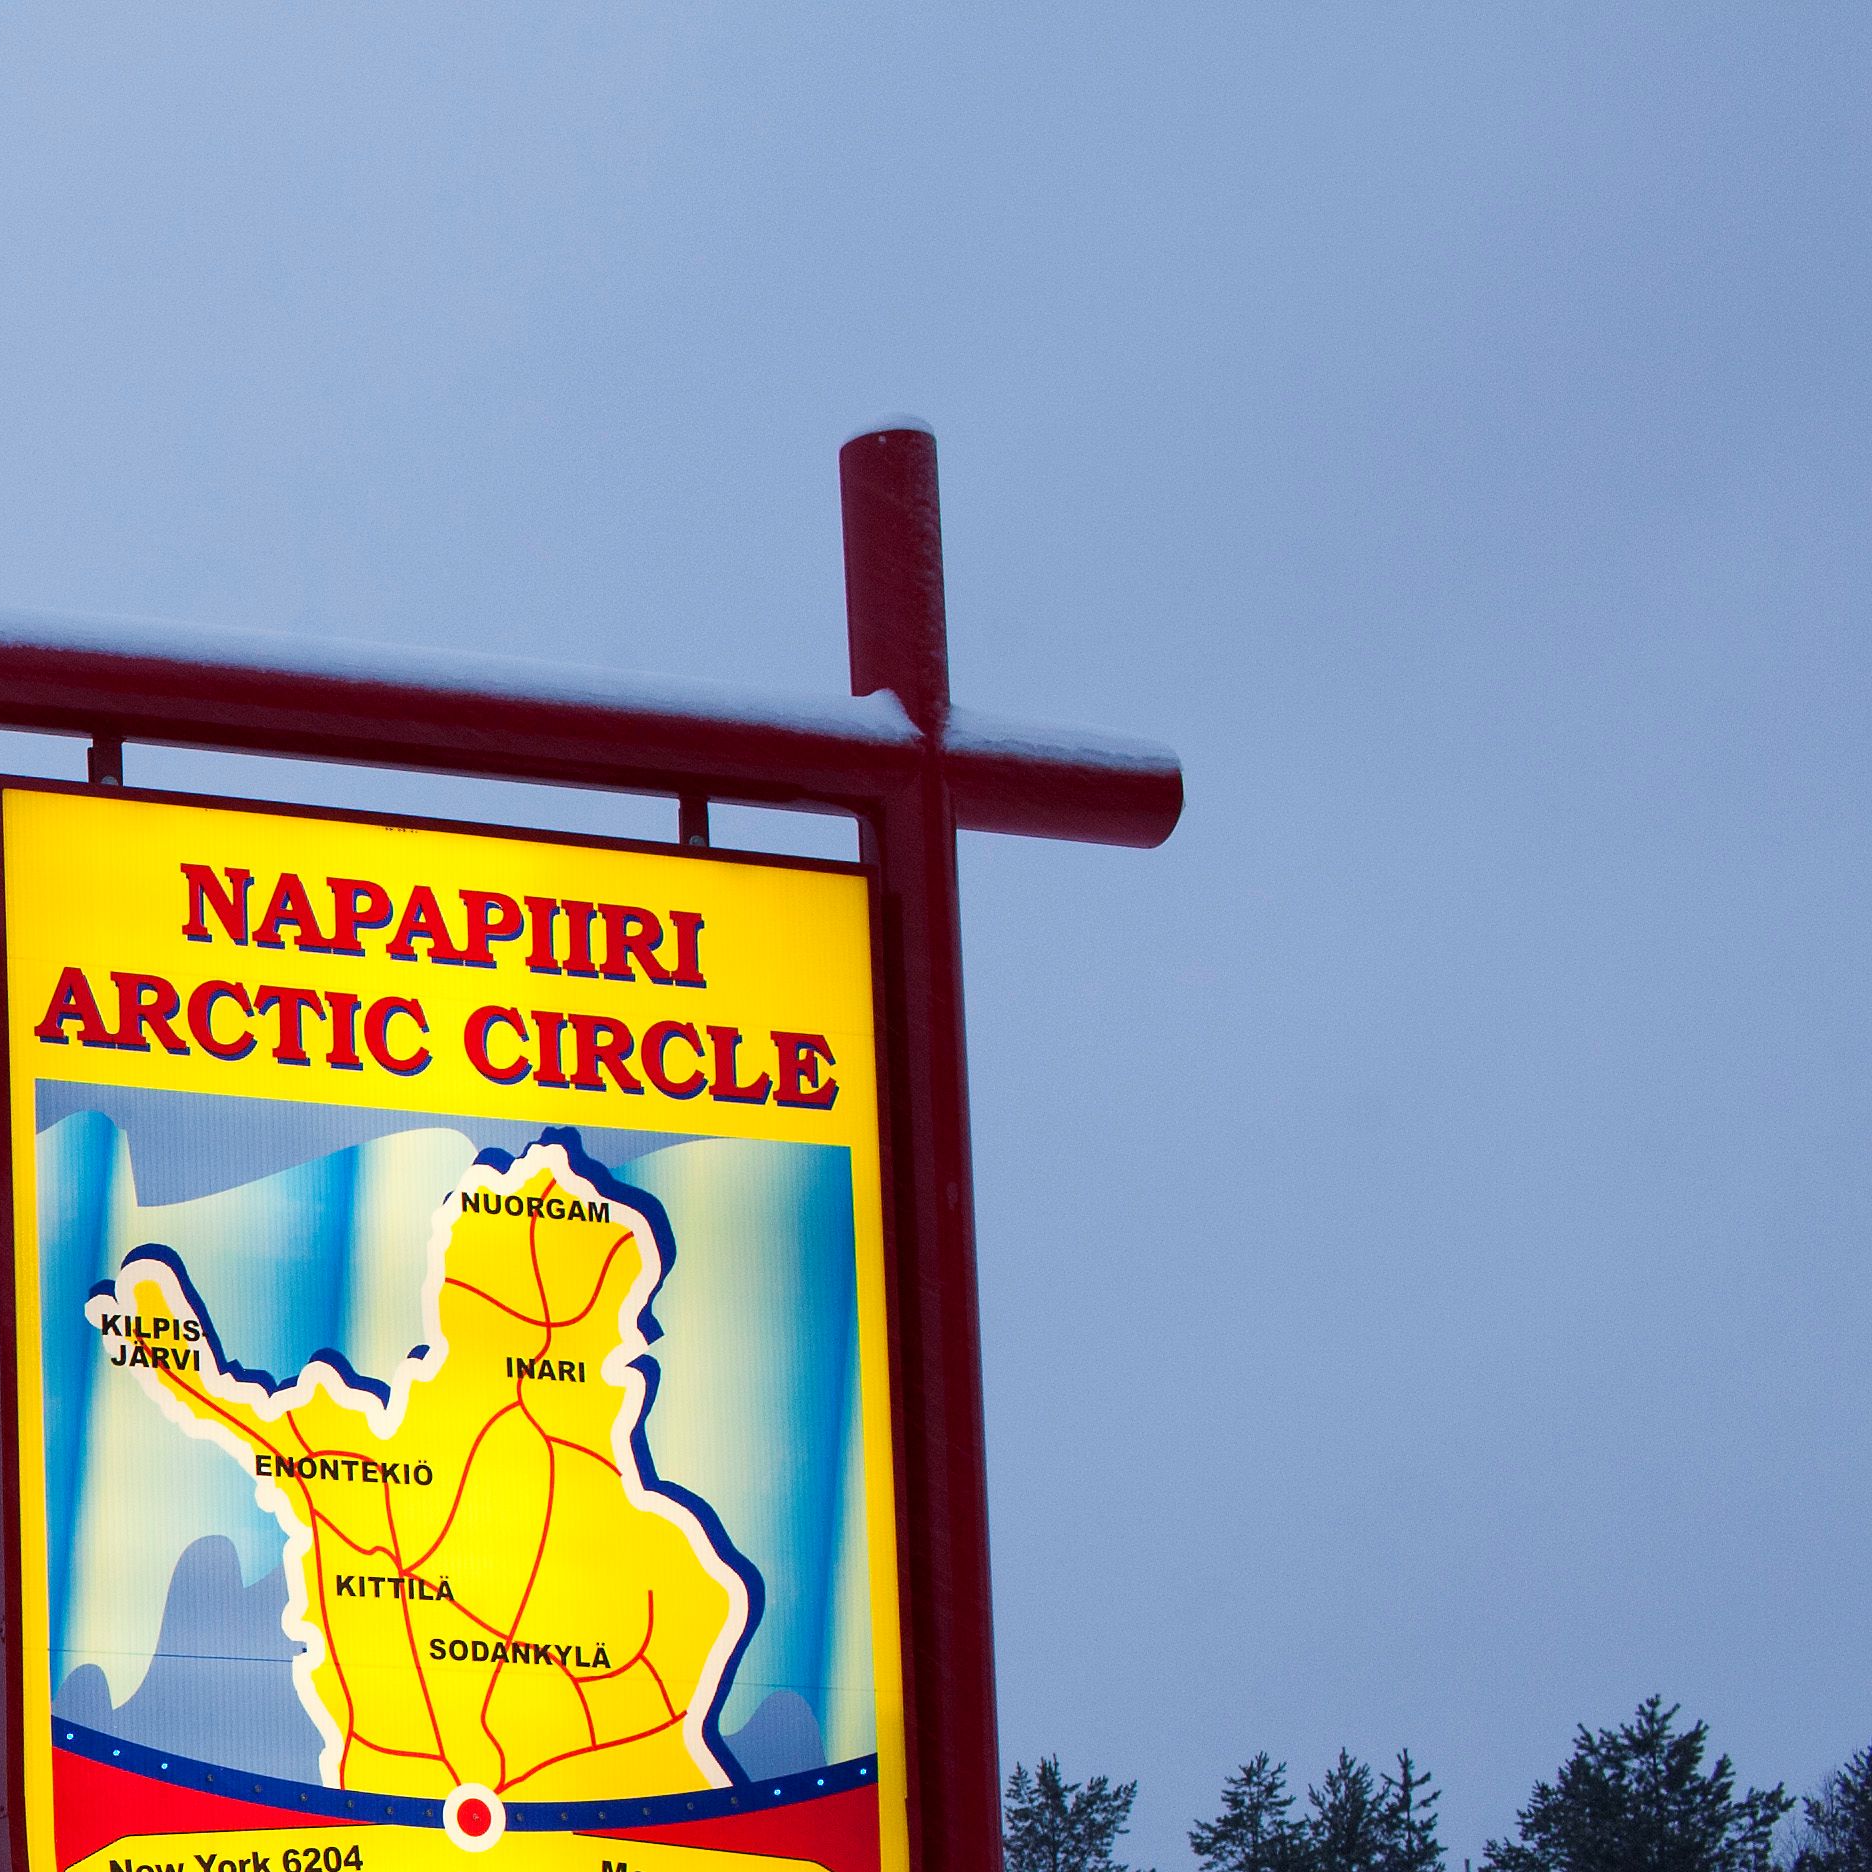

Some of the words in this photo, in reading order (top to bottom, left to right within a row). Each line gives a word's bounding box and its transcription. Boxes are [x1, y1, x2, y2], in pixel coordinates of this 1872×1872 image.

[181, 863, 706, 988] NAPAPIIRI
[34, 967, 433, 1076] ARCTIC
[464, 1006, 839, 1110] CIRCLE
[461, 1192, 611, 1223] NUORGAM
[110, 1340, 200, 1371] JÄRVI
[507, 1357, 584, 1382] INARI
[256, 1455, 432, 1485] ENONTEKIÖ
[337, 1575, 454, 1600] KITTILÄ
[431, 1639, 610, 1668] SODANKYLÄ
